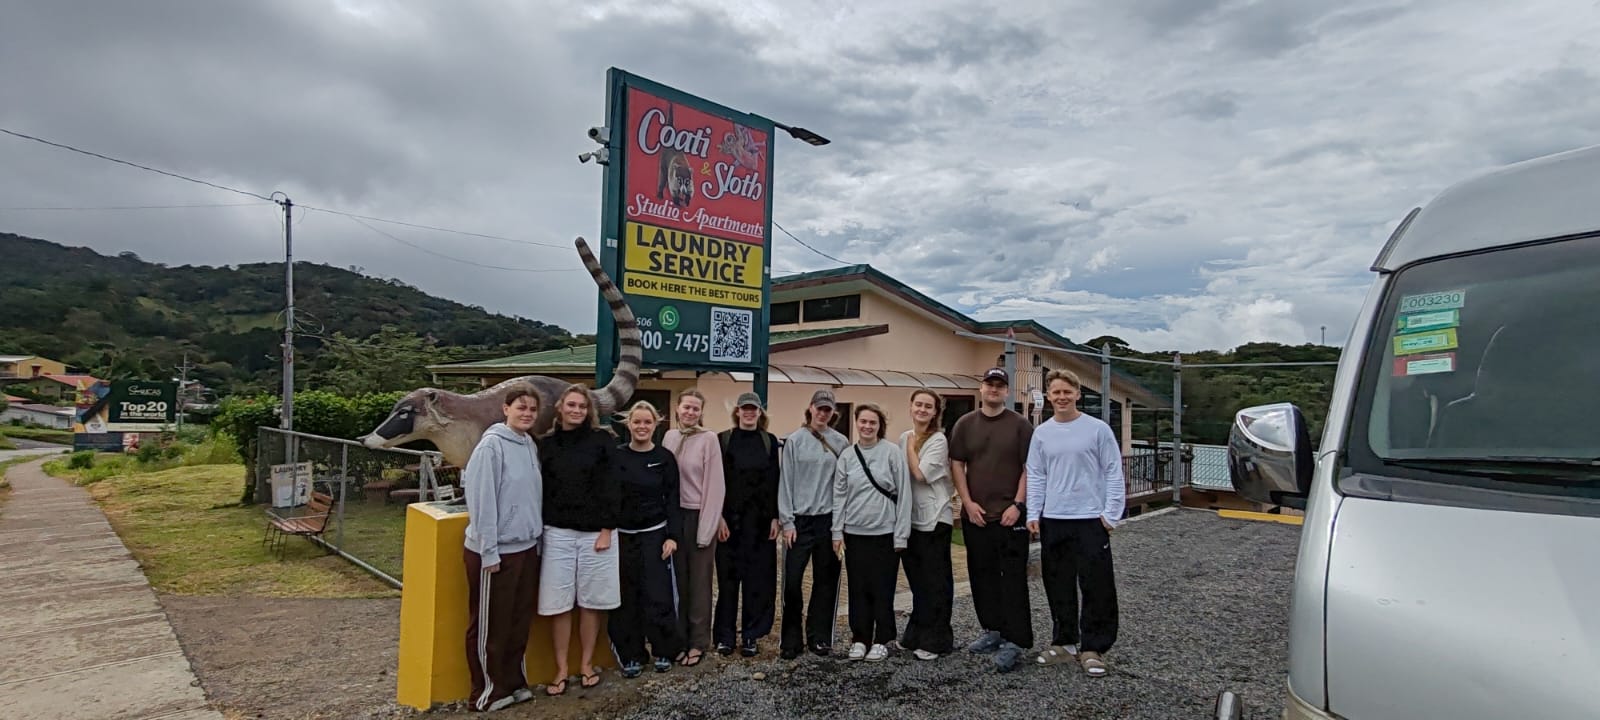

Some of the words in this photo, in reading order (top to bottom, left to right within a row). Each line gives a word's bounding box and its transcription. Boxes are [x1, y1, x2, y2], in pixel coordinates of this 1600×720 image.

[638, 108, 712, 158] Coati
[701, 162, 711, 176] &
[701, 162, 763, 200] Sloth
[627, 193, 680, 219] Studio
[682, 207, 764, 236] Apartments
[636, 225, 751, 263] LAUNDRY
[648, 251, 745, 284] SERVICE
[627, 278, 658, 290] BOOK
[660, 282, 687, 294] HERE
[688, 286, 707, 297] THE
[708, 288, 730, 299] BEST
[731, 291, 760, 303] TOURS
[1409, 293, 1461, 308] 003230
[636, 317, 652, 327] 506
[674, 332, 709, 353] 7475
[274, 465, 306, 474] LAUNRY
